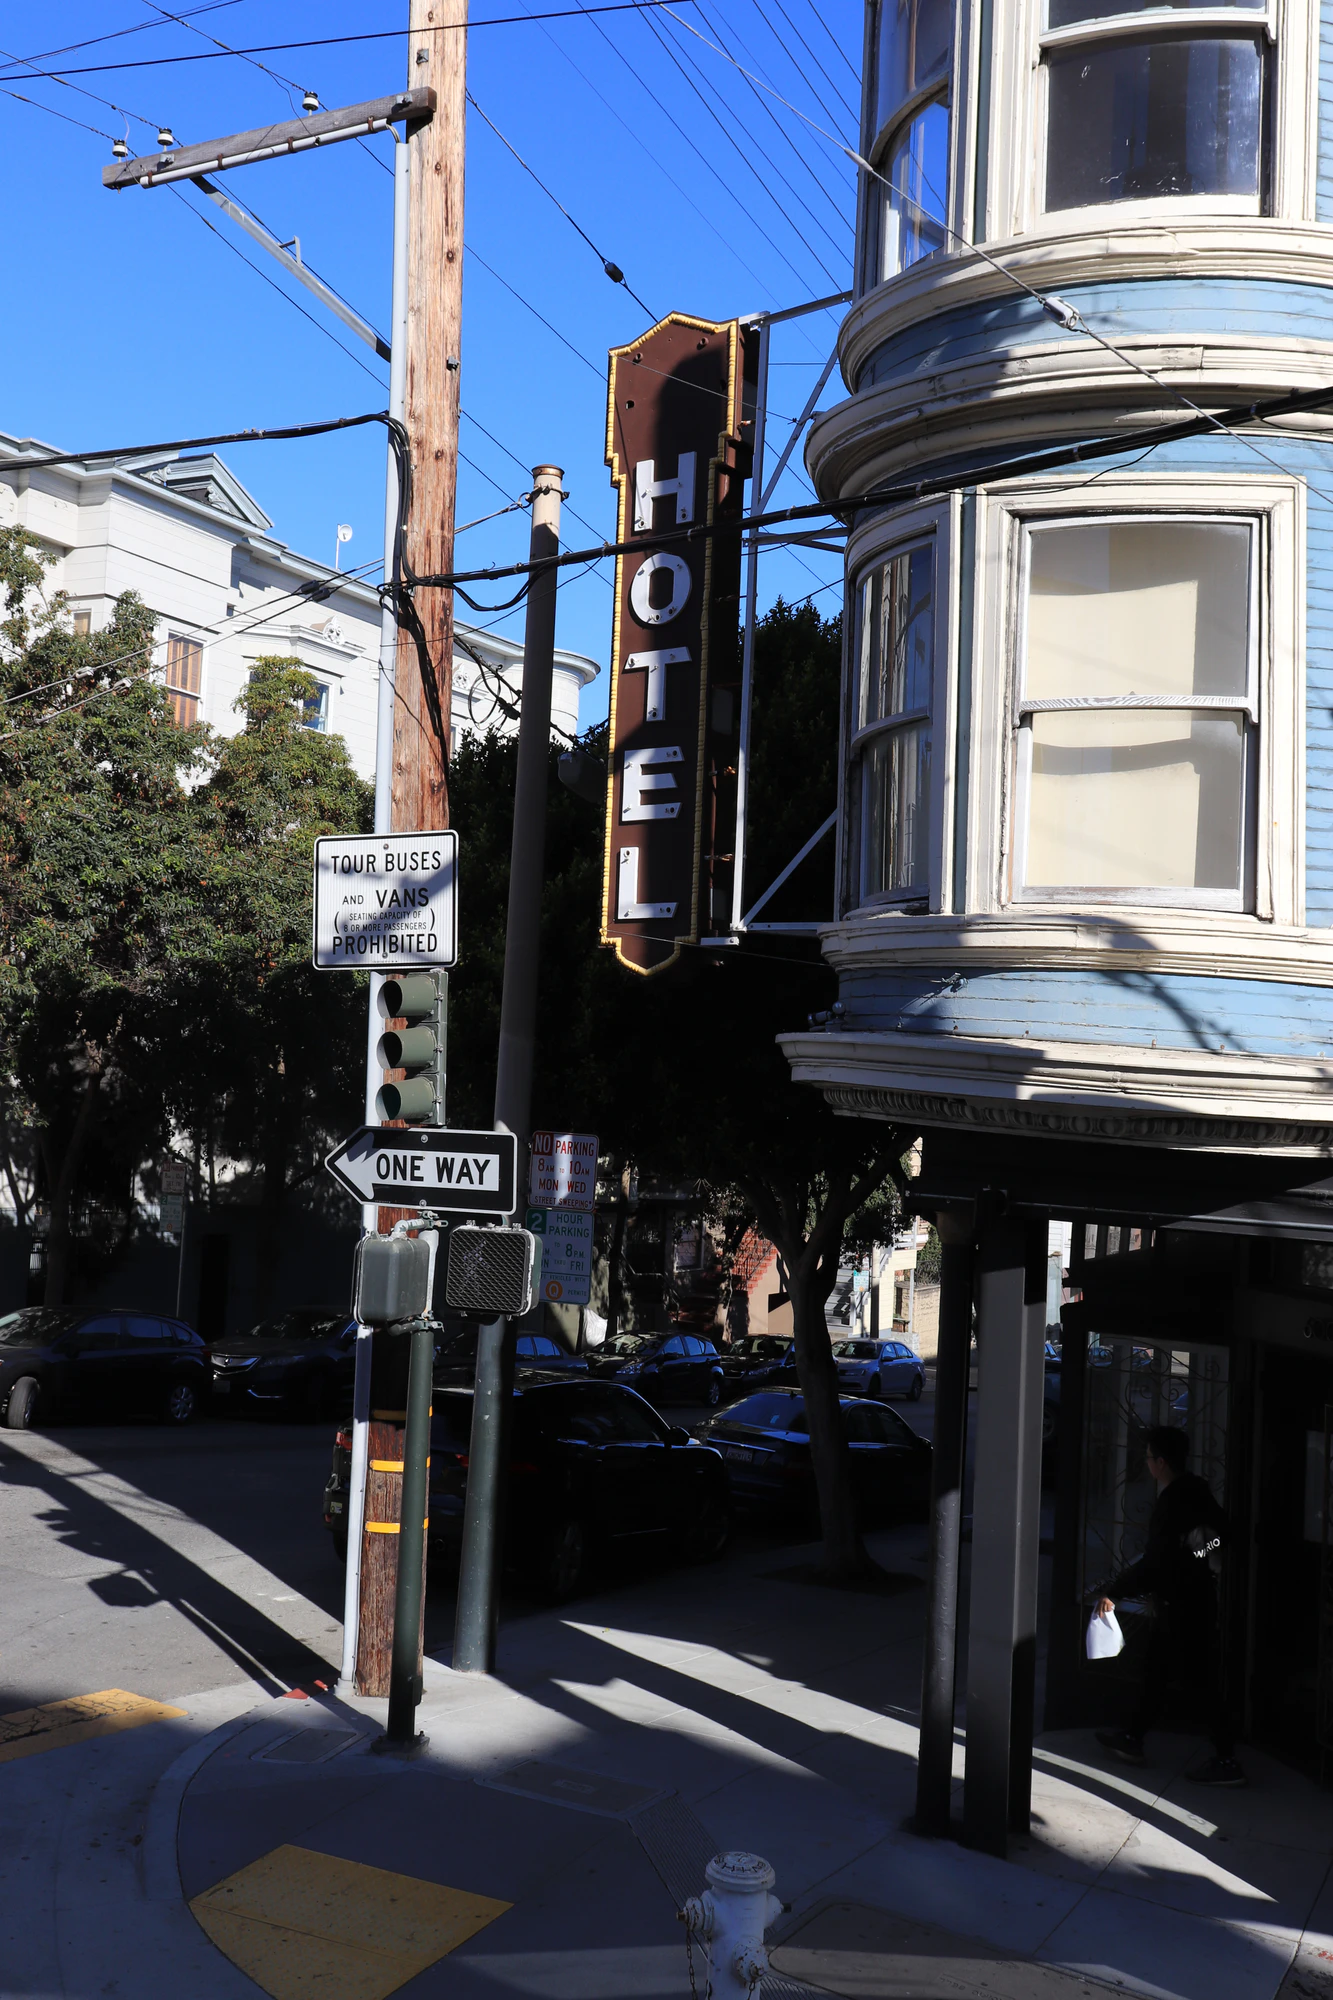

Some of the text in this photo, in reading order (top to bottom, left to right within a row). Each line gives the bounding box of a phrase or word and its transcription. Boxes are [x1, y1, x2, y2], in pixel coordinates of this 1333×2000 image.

[618, 451, 697, 919] HOTEL
[331, 851, 441, 874] TOUR BUSES
[342, 887, 429, 908] AND VANS
[349, 910, 422, 920] SEATING CAPACITY OF
[343, 921, 427, 932] 8 OR MORE PASSENGERS
[332, 933, 438, 955] PROHIBITED
[535, 1133, 595, 1156] NO PARKING
[376, 1153, 490, 1185] ONE WAY
[538, 1178, 586, 1193] MON WED
[534, 1195, 556, 1205] STREET
[530, 1213, 583, 1231] 2 HOUR
[549, 1226, 590, 1238] PARKING
[570, 1261, 584, 1271] FRI
